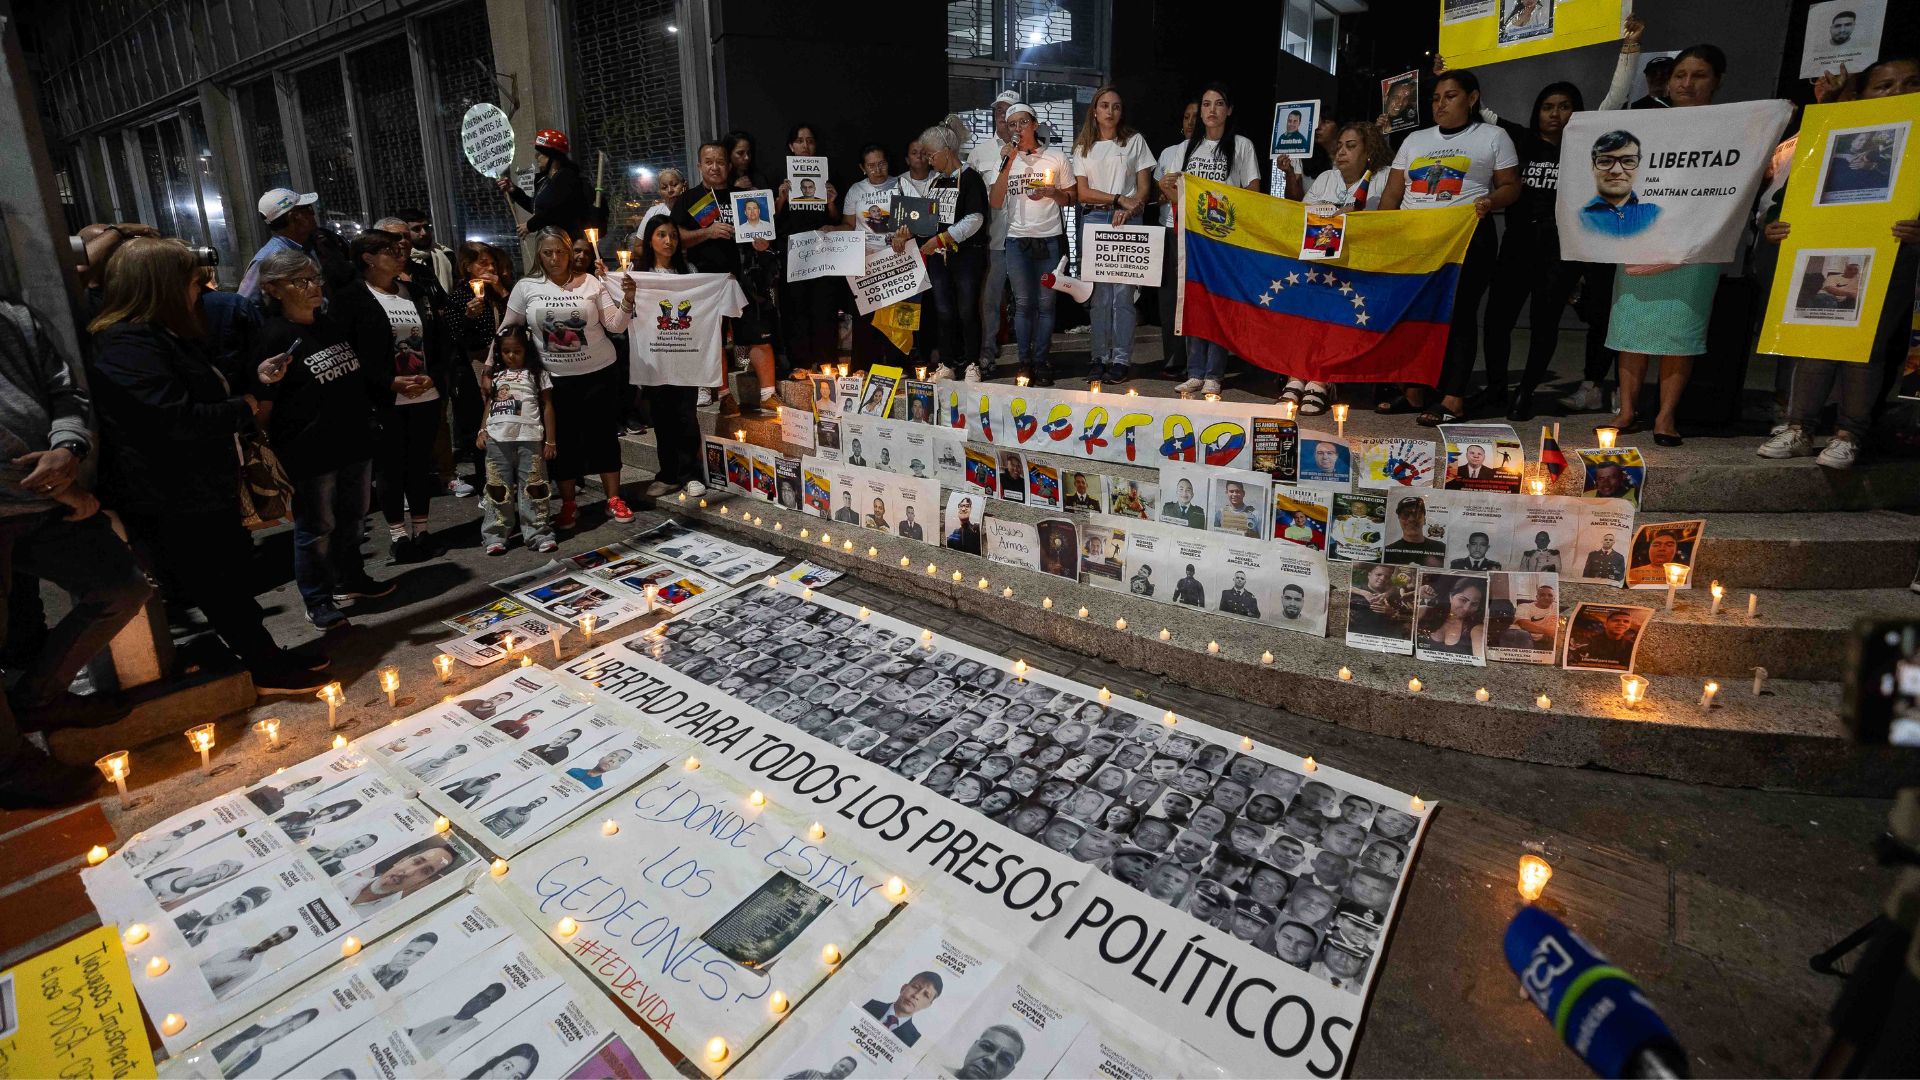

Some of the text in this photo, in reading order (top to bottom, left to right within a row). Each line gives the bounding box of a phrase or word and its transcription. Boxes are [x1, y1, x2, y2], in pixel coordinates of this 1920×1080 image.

[1199, 163, 1228, 171] PRESOS
[1649, 149, 1740, 169] LIBERTAD
[1642, 186, 1737, 197] JONATHAN CARRILLO
[740, 230, 773, 239] LIBERTAD
[1096, 253, 1150, 264] POLÍTICOS
[1112, 245, 1150, 254] PRESOS
[858, 262, 917, 288] LIBERTAD DE TODOS
[872, 255, 913, 275] DE PAZ ES LA
[865, 273, 915, 296] LOS PRESOS
[867, 281, 917, 304] POLÍTICOS
[304, 344, 341, 366] CIERREN
[310, 351, 353, 374] CENTROS
[950, 391, 1246, 466] LIBERTAD
[520, 621, 550, 636] TODOS
[565, 652, 1353, 1080] LIBERTAD PARA TODOS LOS PRESOS POLÍTICOS
[641, 846, 715, 899] LOS
[764, 835, 883, 907] ESTÁN
[298, 906, 311, 926] ROBERTO
[311, 900, 337, 931] LIBERTAD PARA
[536, 855, 772, 1011] GEDEONES?
[935, 954, 965, 975] GUEVARA
[942, 952, 967, 969] CARLOS
[574, 936, 675, 1032] #FEDEVIDA
[1012, 1002, 1045, 1029] GUEVARA
[1017, 999, 1047, 1023] OTONIEL
[1038, 1000, 1062, 1020] LIBERTAD
[555, 1018, 575, 1042] OROZCO
[559, 1012, 584, 1041] ANDREINA
[850, 1025, 894, 1064] JOSÉ GABRIEL
[855, 1038, 880, 1059] OCHOA
[383, 1047, 399, 1070] DANIEL
[1105, 1060, 1134, 1080] DANIEL
